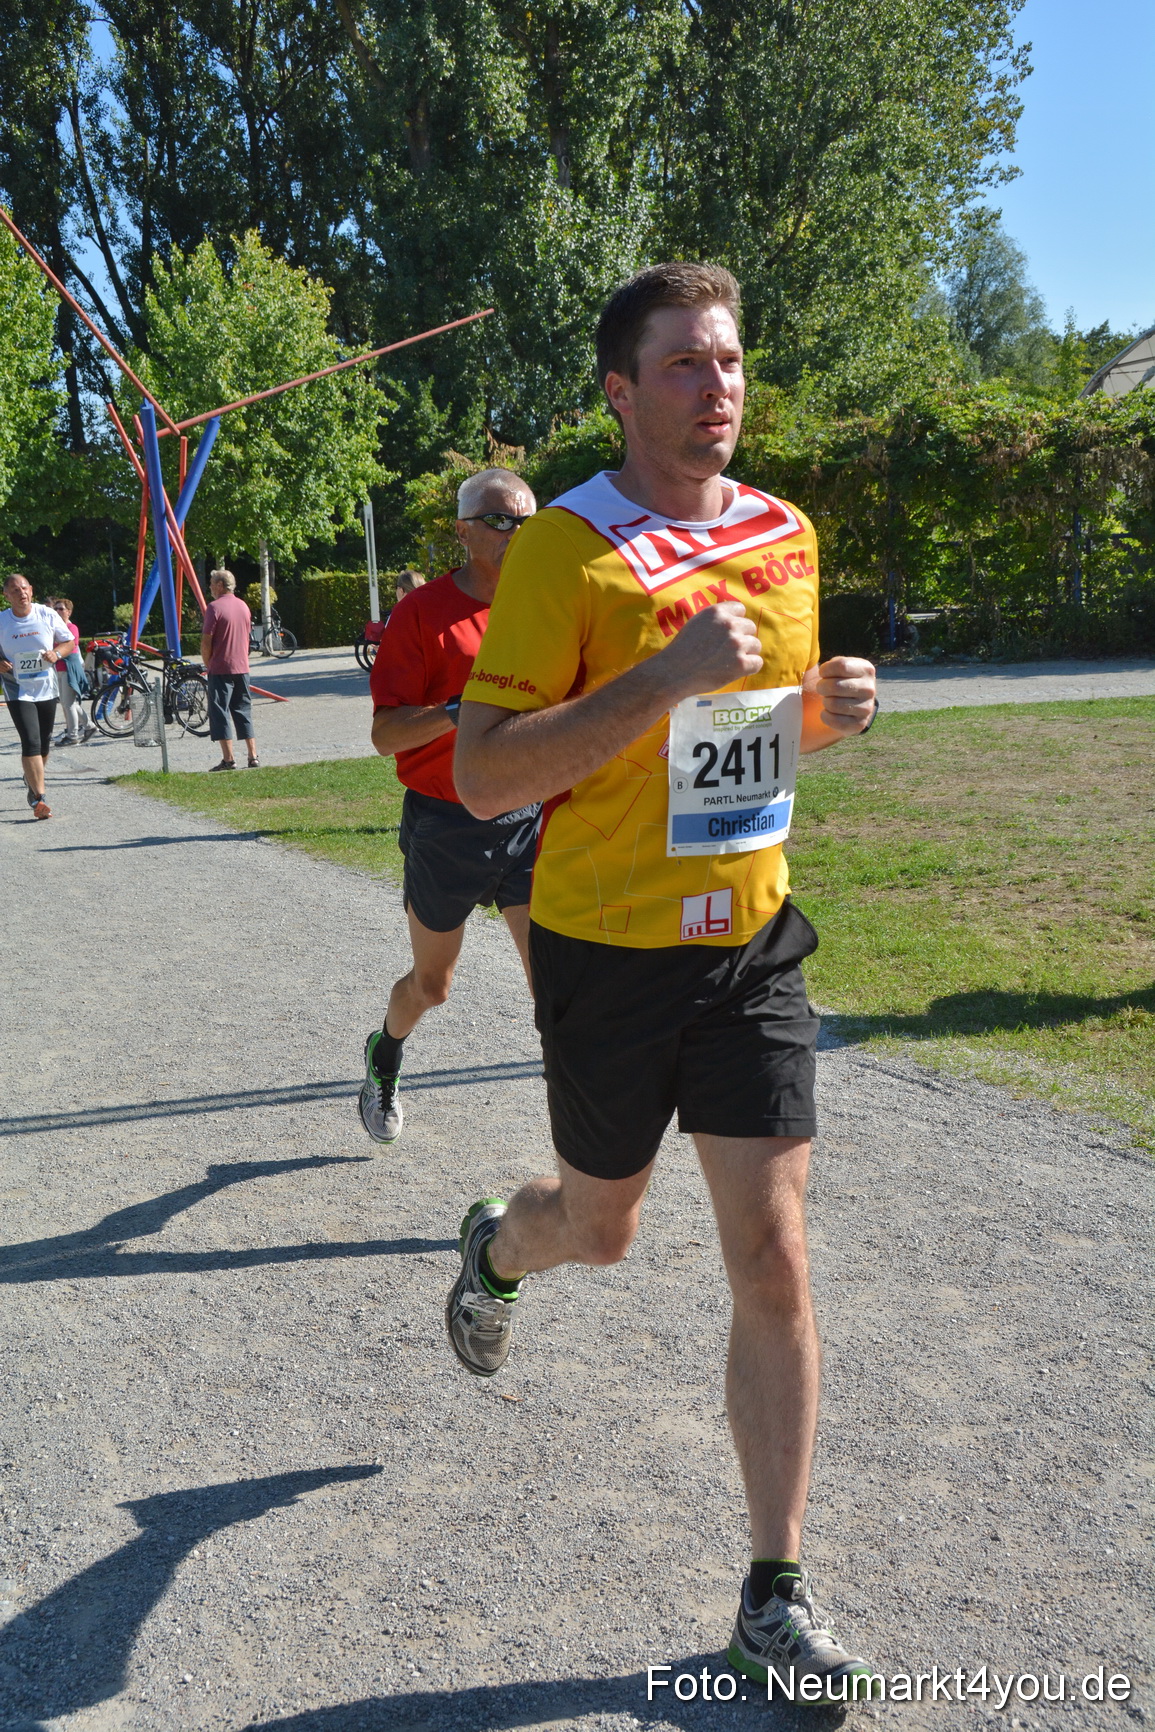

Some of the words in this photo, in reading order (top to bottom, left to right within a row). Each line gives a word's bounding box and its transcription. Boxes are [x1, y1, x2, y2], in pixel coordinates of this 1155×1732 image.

[741, 549, 815, 597] BÖGL
[20, 659, 43, 670] 2271
[713, 705, 772, 726] BOCK
[692, 733, 780, 789] 2411
[703, 795, 735, 806] PARTL
[736, 790, 771, 803] Neumarkt
[708, 813, 775, 837] Christian
